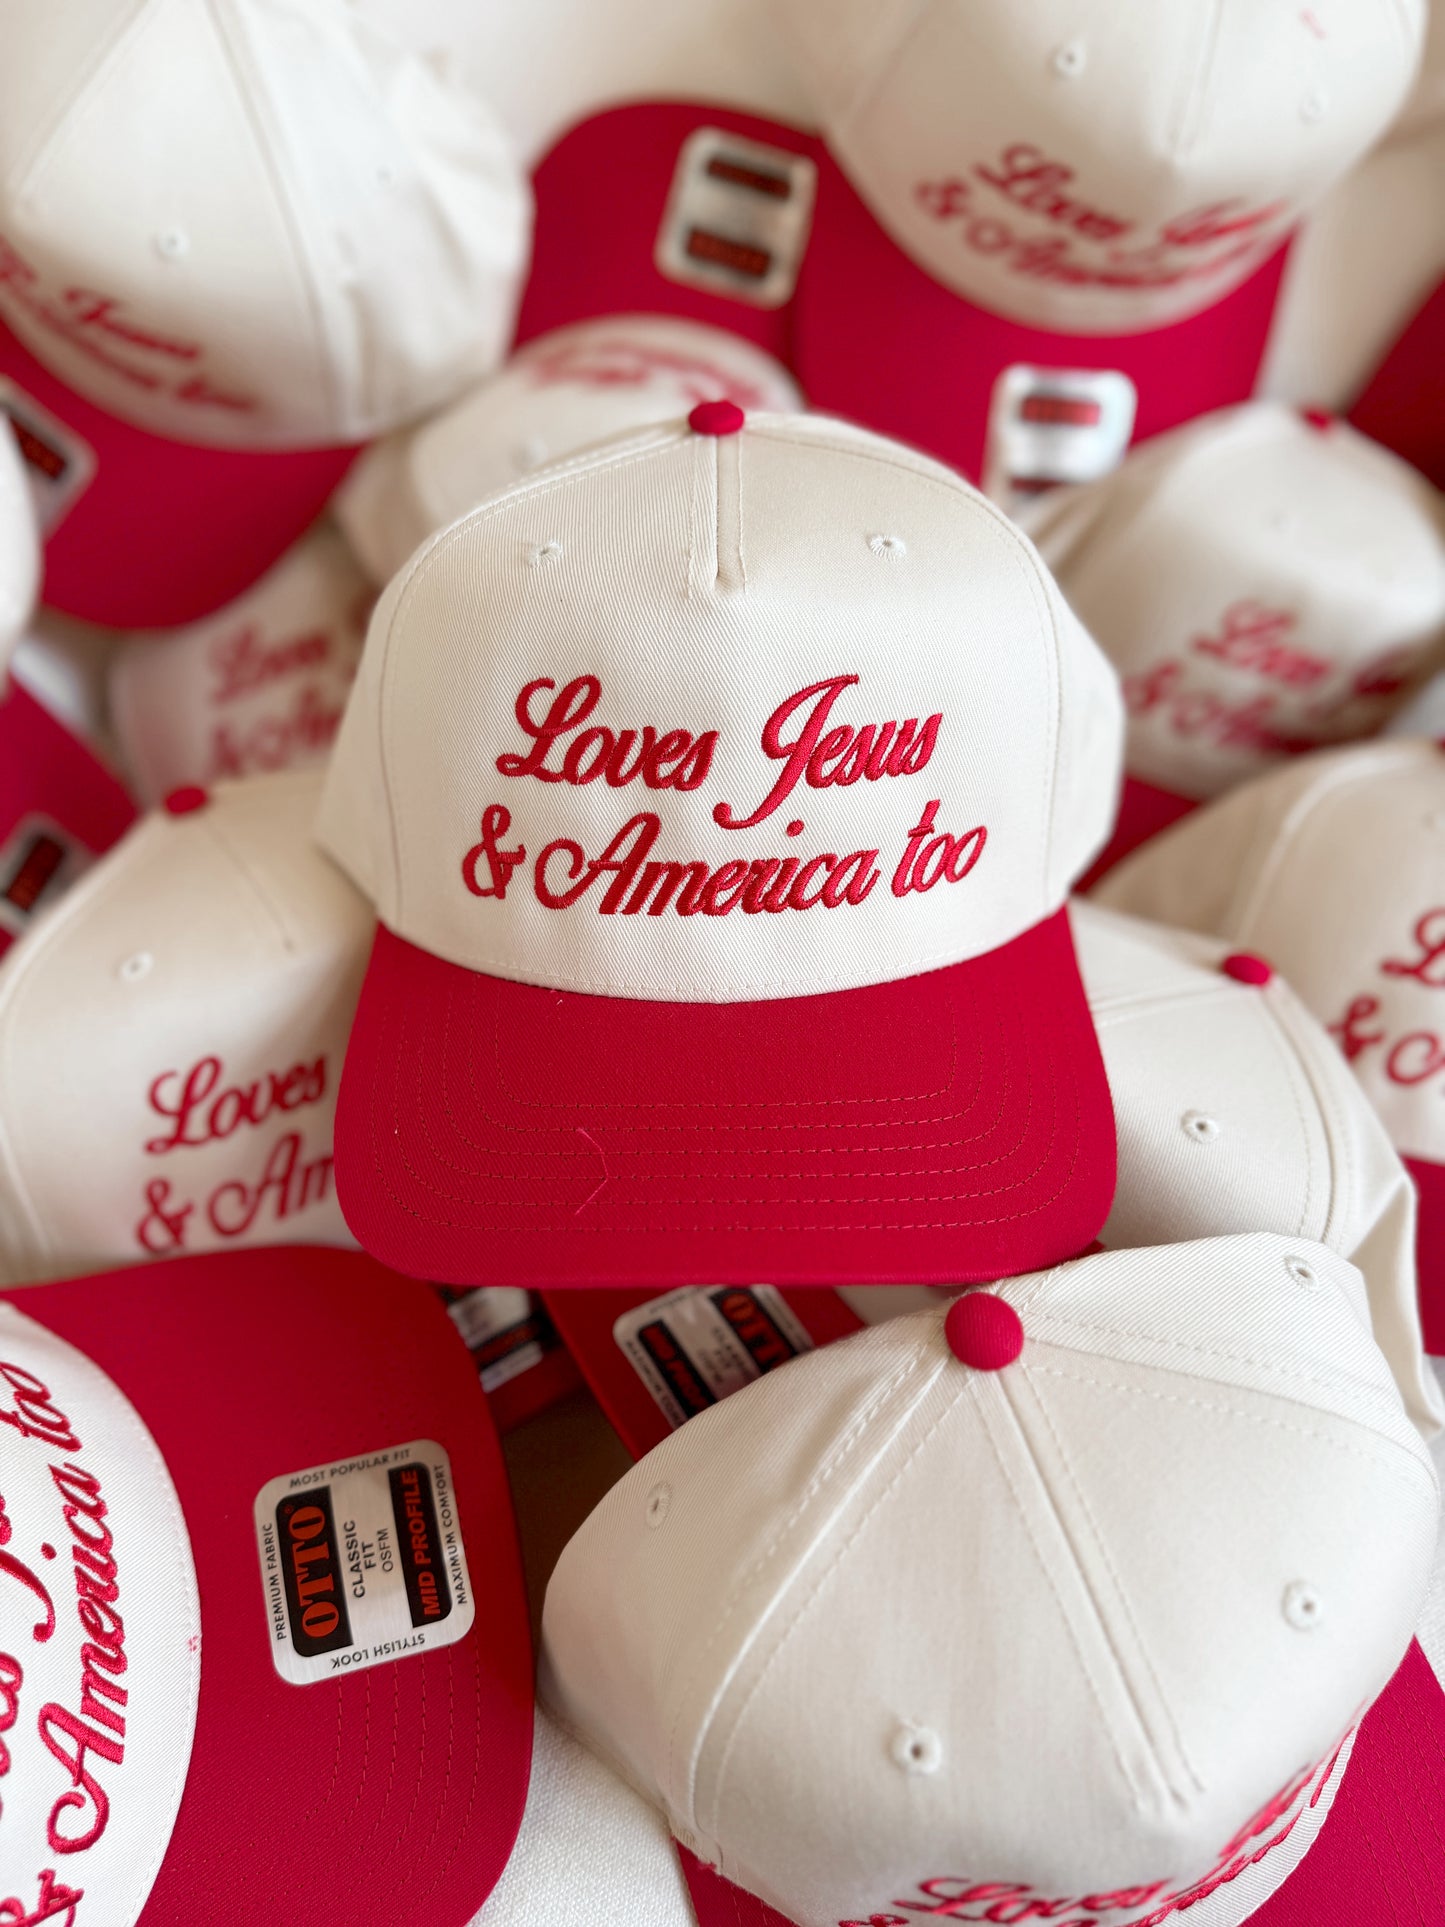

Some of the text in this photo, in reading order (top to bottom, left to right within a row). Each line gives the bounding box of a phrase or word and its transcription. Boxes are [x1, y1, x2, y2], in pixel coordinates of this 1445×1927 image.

[496, 674, 718, 791] Loves
[712, 674, 943, 830] Jesus
[462, 799, 988, 916] & America too
[145, 1055, 326, 1154] Loves
[136, 1178, 193, 1253] &
[722, 1293, 793, 1370] OTT
[290, 1448, 411, 1488] MOST POPULAR FIT
[262, 1522, 287, 1641] PREMIUM FABRIC
[289, 1505, 340, 1638] OTTO
[343, 1520, 366, 1599] CLASSIC
[362, 1542, 377, 1570] FIT
[377, 1528, 394, 1572] OSFM
[402, 1469, 441, 1616] MID PROFILE
[434, 1464, 467, 1605] MAXIMUM COMFORT
[37, 1462, 128, 1853] America
[330, 1633, 426, 1669] STYLISH LOOK
